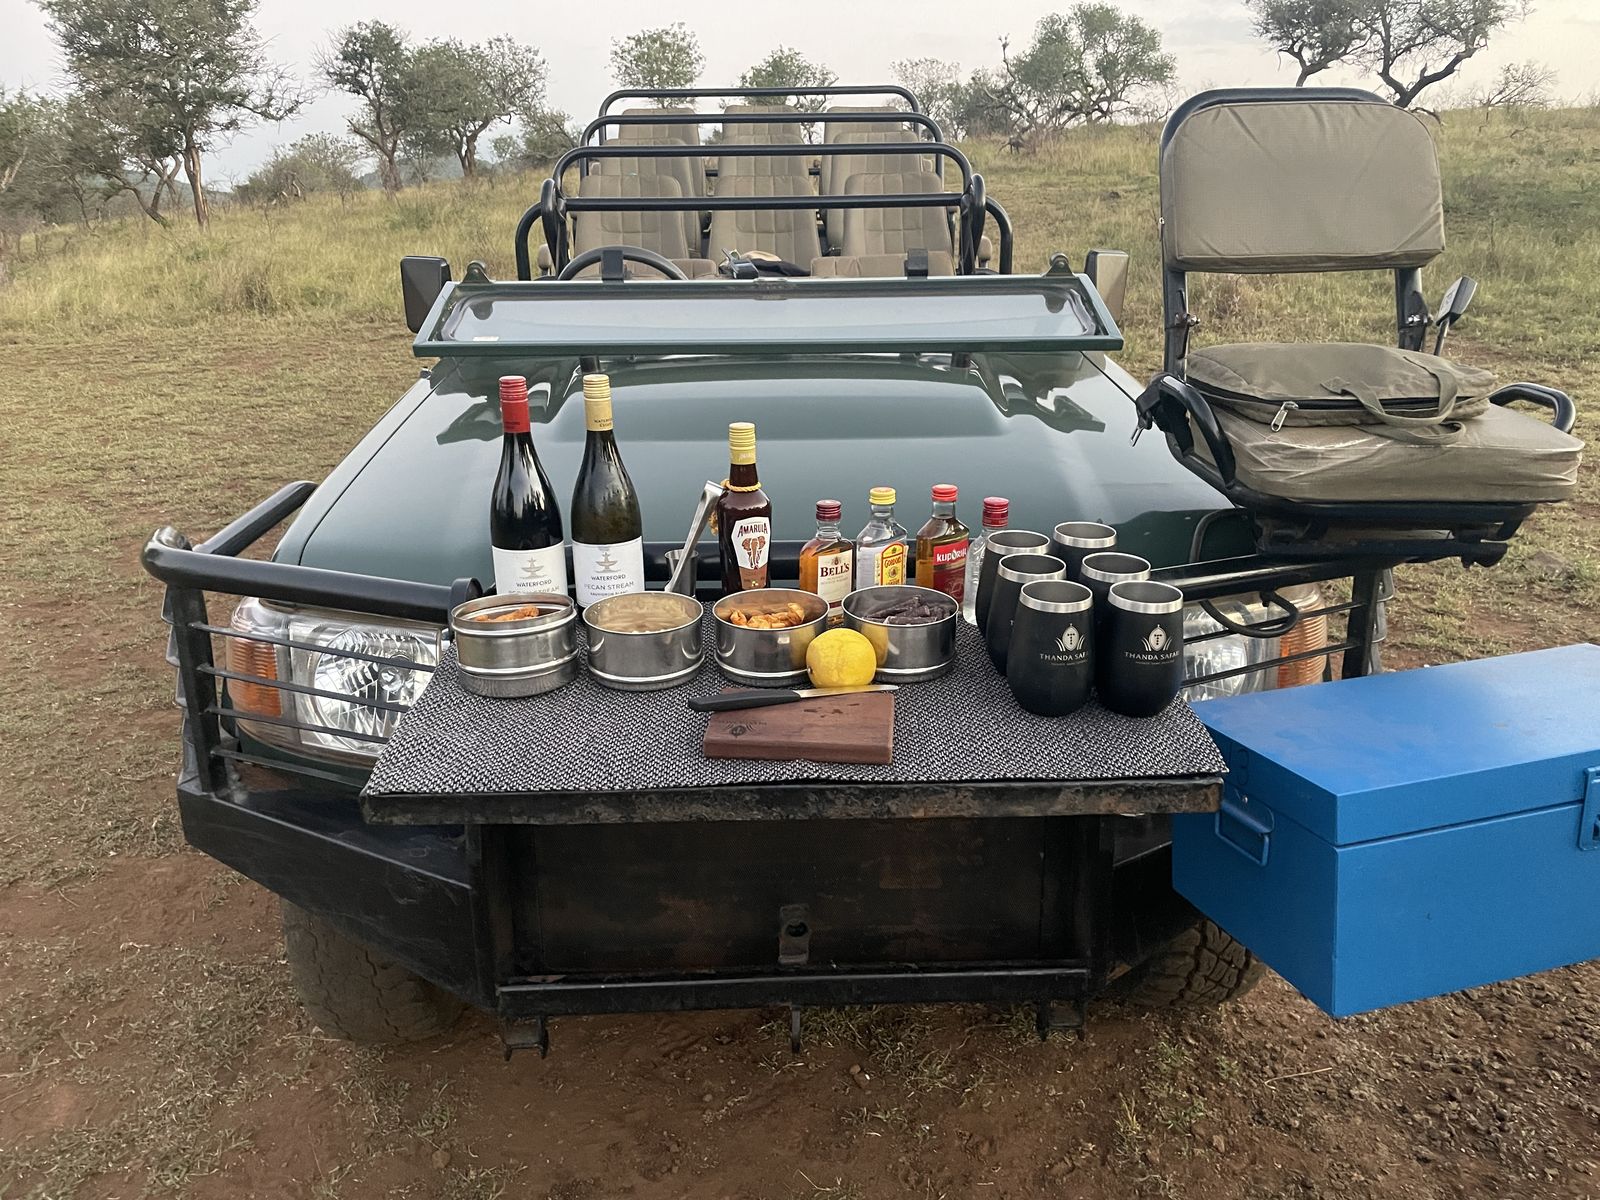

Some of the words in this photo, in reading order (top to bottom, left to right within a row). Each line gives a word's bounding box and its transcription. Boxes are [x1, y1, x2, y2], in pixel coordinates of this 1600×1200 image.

[737, 523, 768, 537] AMARULA
[820, 563, 850, 577] BELL'S
[516, 579, 552, 588] WATERFORD
[607, 580, 634, 590] STREAM
[1040, 653, 1073, 661] THANDA
[1124, 651, 1158, 660] THANDA
